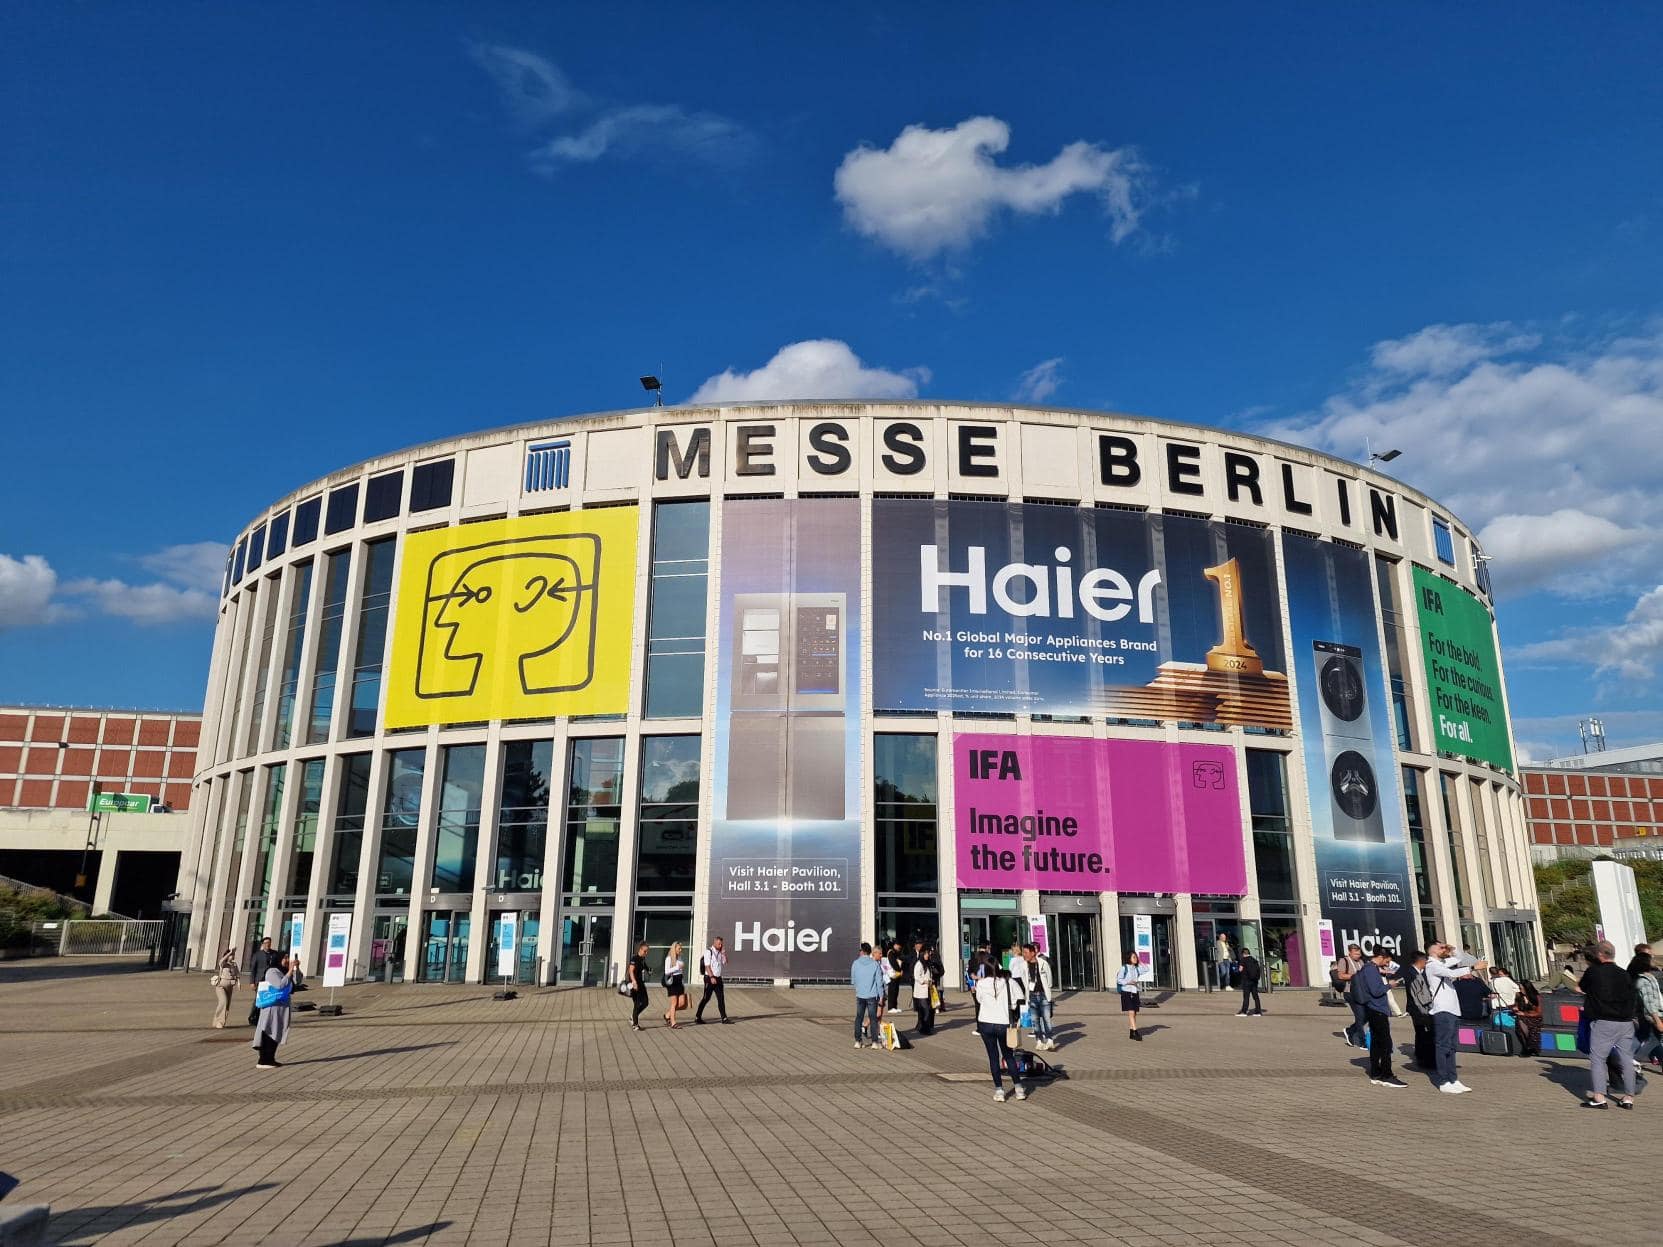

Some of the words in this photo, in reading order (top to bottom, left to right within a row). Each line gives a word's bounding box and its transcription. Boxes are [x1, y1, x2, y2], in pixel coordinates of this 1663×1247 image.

[656, 422, 999, 481] MESSE
[1098, 434, 1399, 541] BERLIN
[920, 544, 1162, 624] Haier
[1422, 586, 1444, 616] IFA
[923, 630, 952, 642] No.1
[956, 631, 1000, 643] Global
[1004, 632, 1042, 646] Major
[1046, 634, 1117, 649] Appliances
[1120, 638, 1157, 652] Brand
[964, 646, 984, 658] for
[988, 647, 1003, 659] 16
[1006, 648, 1086, 662] Consecutive
[1089, 652, 1125, 665] Years
[1428, 631, 1446, 656] For
[1447, 640, 1463, 662] the
[1462, 646, 1483, 673] bold.
[1224, 659, 1248, 671] 2024
[1432, 658, 1449, 683] For
[1451, 665, 1467, 689] the
[1436, 686, 1453, 711] For
[1454, 692, 1470, 716] the
[1470, 698, 1492, 725] keen.
[1439, 714, 1457, 739] For
[1458, 720, 1473, 744] all.
[969, 749, 1022, 781] IFA
[99, 798, 140, 808] Europcar
[969, 807, 1078, 841] Imagine
[729, 865, 754, 877] Visit
[757, 865, 788, 877] Haier
[792, 866, 841, 879] Pavilion,
[970, 843, 1016, 871] the
[1022, 845, 1110, 874] future.
[728, 881, 751, 891] Hall
[753, 881, 769, 891] 3.1
[781, 881, 815, 891] Booth
[818, 881, 841, 891] 101.
[1330, 878, 1347, 888] Visit
[1349, 879, 1369, 889] Haier
[1371, 880, 1400, 892] Pavilion,
[1331, 892, 1348, 901] Hall
[1348, 892, 1360, 902] 3.1
[1366, 893, 1387, 903] Booth
[1388, 894, 1402, 903] 101.
[734, 920, 833, 953] Haier
[1341, 928, 1402, 958] Haier
